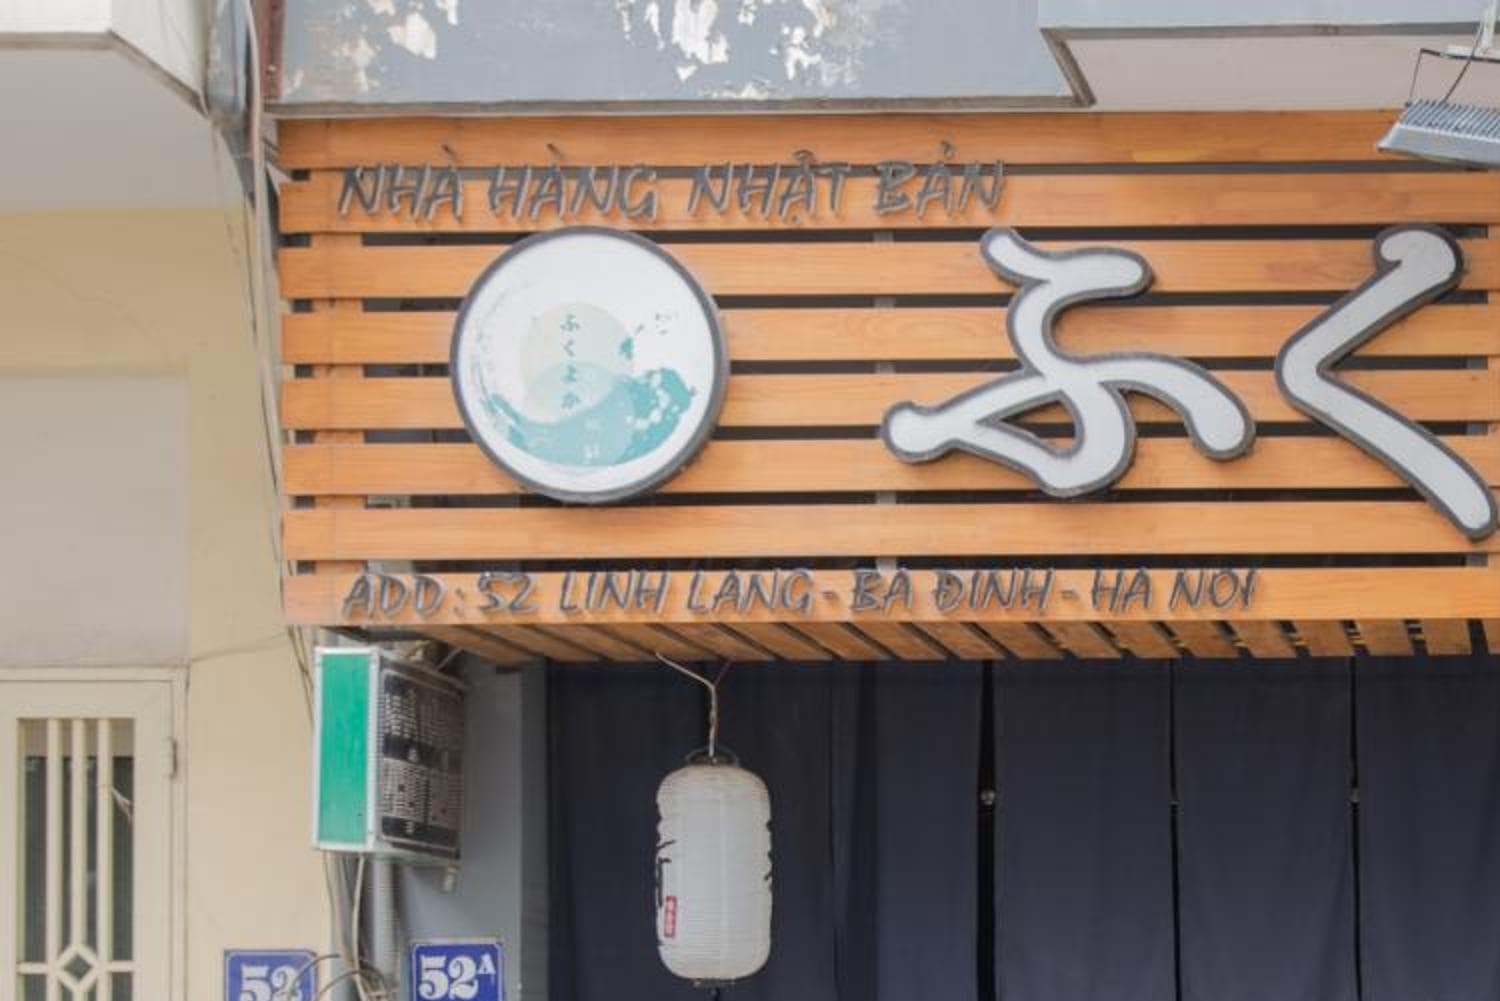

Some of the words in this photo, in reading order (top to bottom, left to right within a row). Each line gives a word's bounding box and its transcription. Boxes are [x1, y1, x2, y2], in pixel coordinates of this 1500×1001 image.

[337, 144, 464, 221] NHÀ
[488, 143, 657, 221] HÀNG
[477, 570, 540, 615] 52
[559, 568, 669, 614] LINH
[418, 952, 497, 1001] 52A
